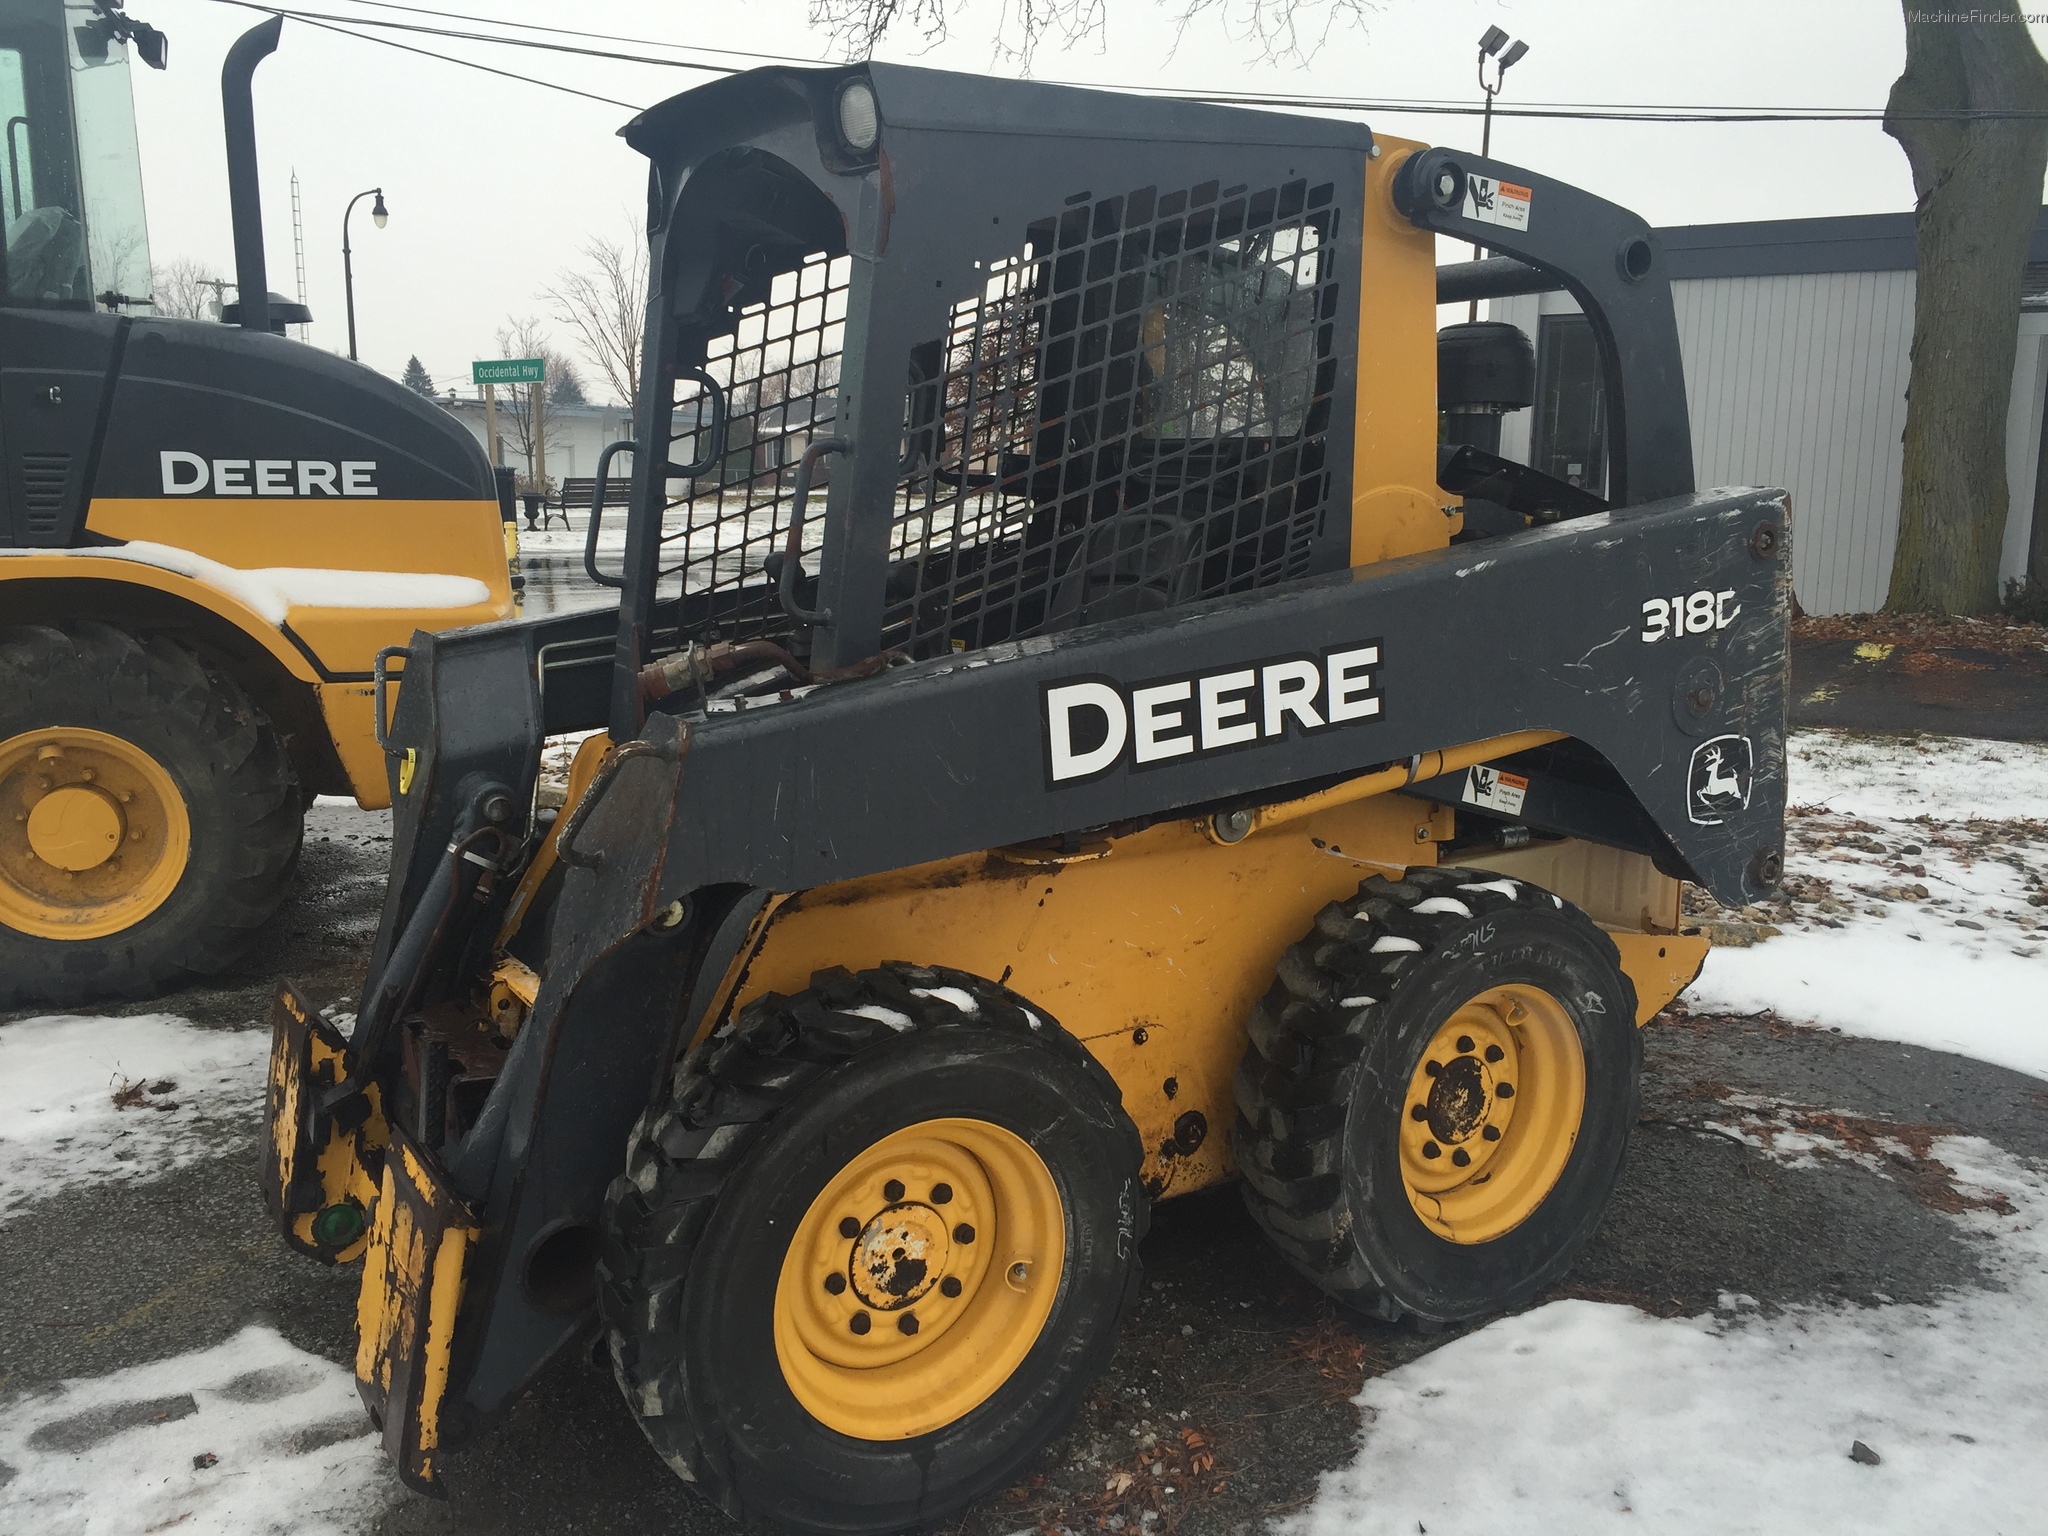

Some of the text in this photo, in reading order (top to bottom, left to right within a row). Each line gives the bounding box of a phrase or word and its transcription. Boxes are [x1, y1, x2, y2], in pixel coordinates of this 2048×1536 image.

[1506, 187, 1529, 198] WARNING
[1501, 201, 1515, 210] Pinch
[478, 364, 539, 379] Occidental Hwy
[160, 450, 379, 496] DEERE
[1641, 590, 1742, 643] 318D
[1047, 646, 1380, 782] DEERE
[1499, 788, 1511, 797] Pinch
